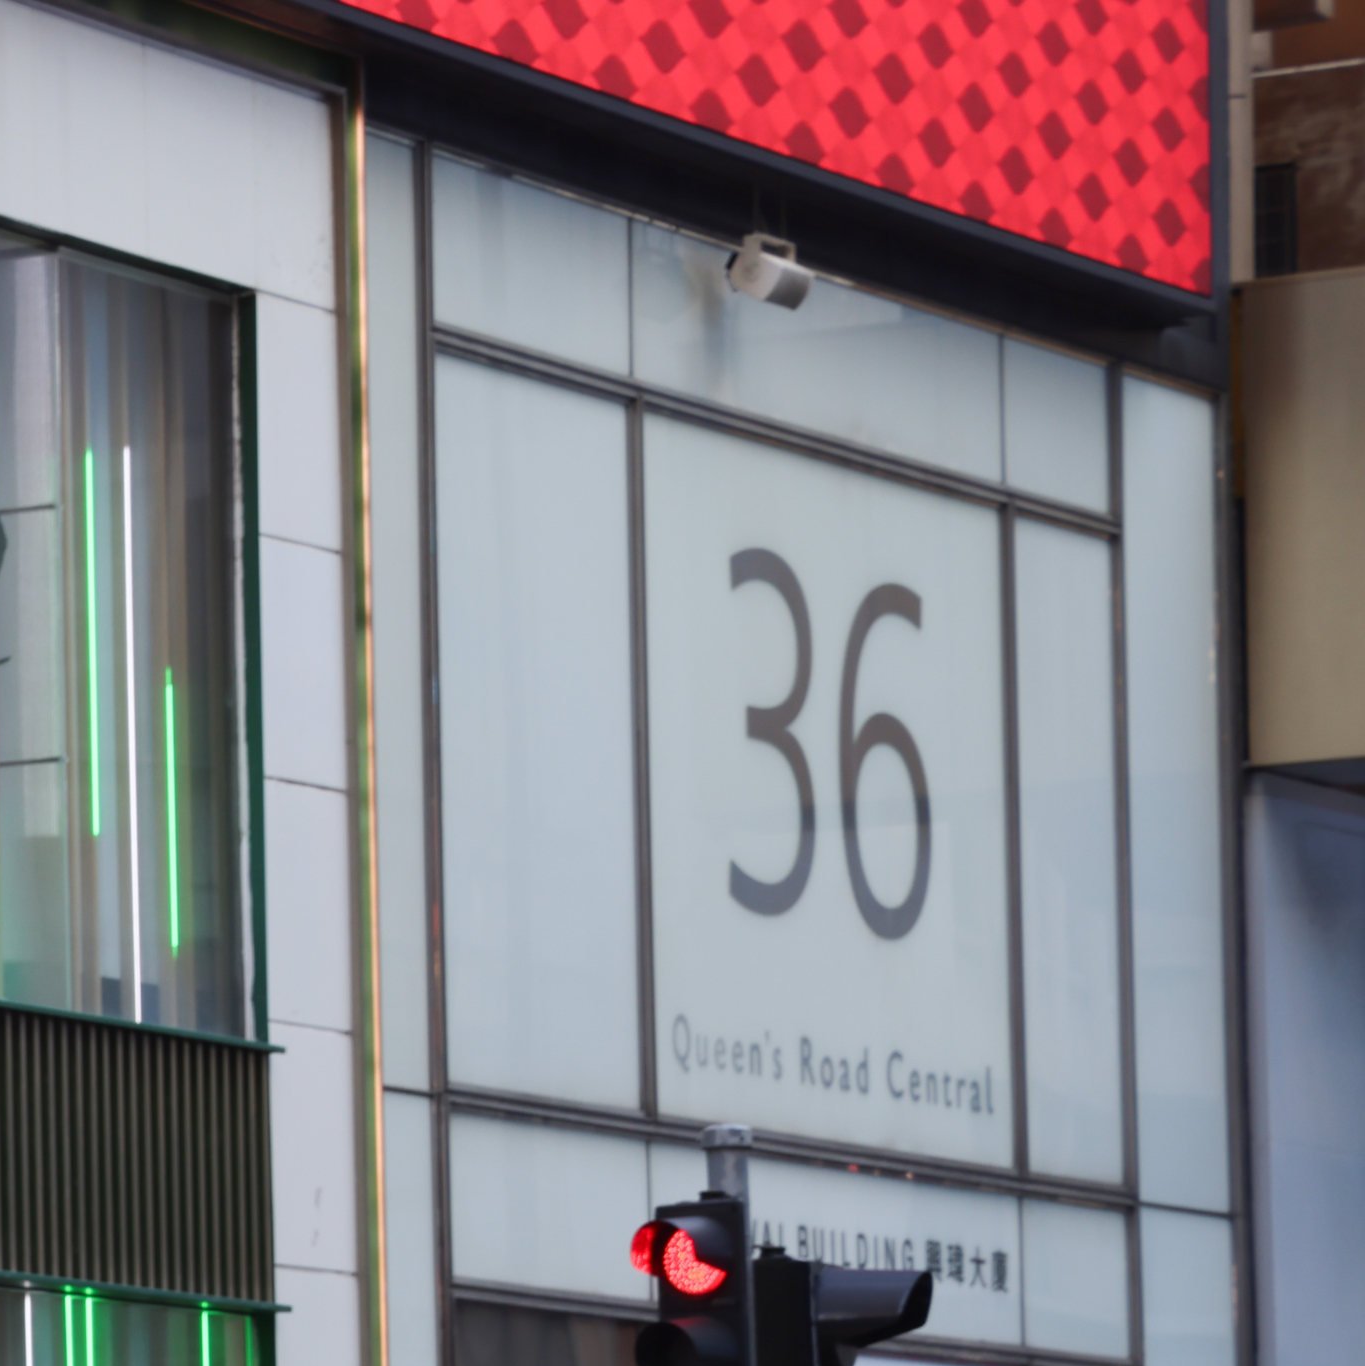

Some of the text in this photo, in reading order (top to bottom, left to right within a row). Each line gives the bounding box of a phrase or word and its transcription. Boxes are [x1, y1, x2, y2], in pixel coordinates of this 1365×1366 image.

[729, 547, 932, 940] 36
[672, 1013, 994, 1115] Queen's Road Central
[797, 1225, 914, 1272] BUILDING
